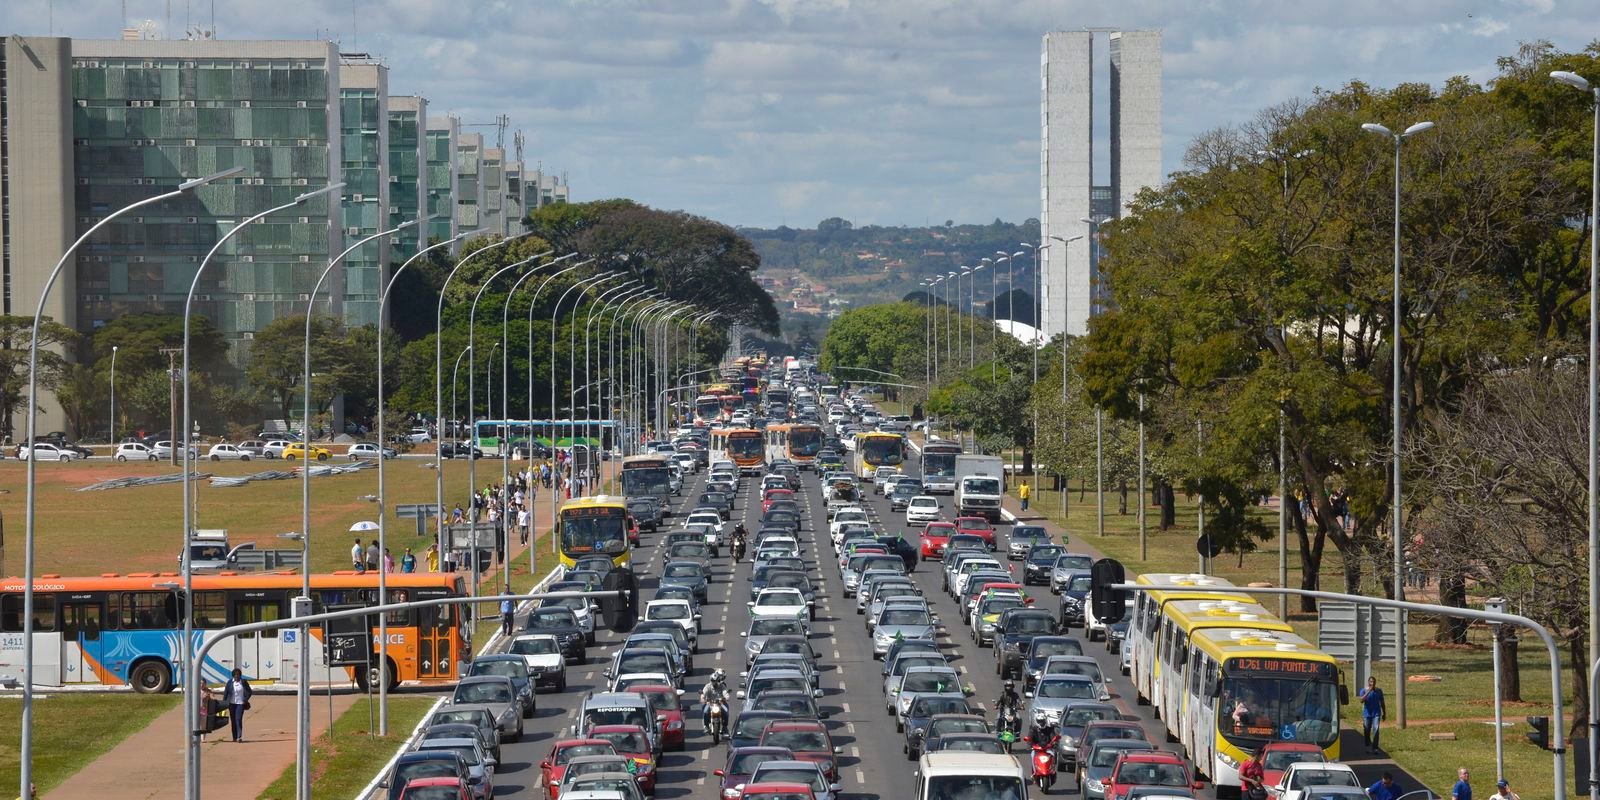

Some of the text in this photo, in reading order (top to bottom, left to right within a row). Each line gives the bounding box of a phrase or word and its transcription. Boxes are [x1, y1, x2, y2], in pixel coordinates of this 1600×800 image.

[1264, 660, 1279, 671] VIA
[1282, 661, 1307, 673] PONTE
[1308, 663, 1319, 673] JK
